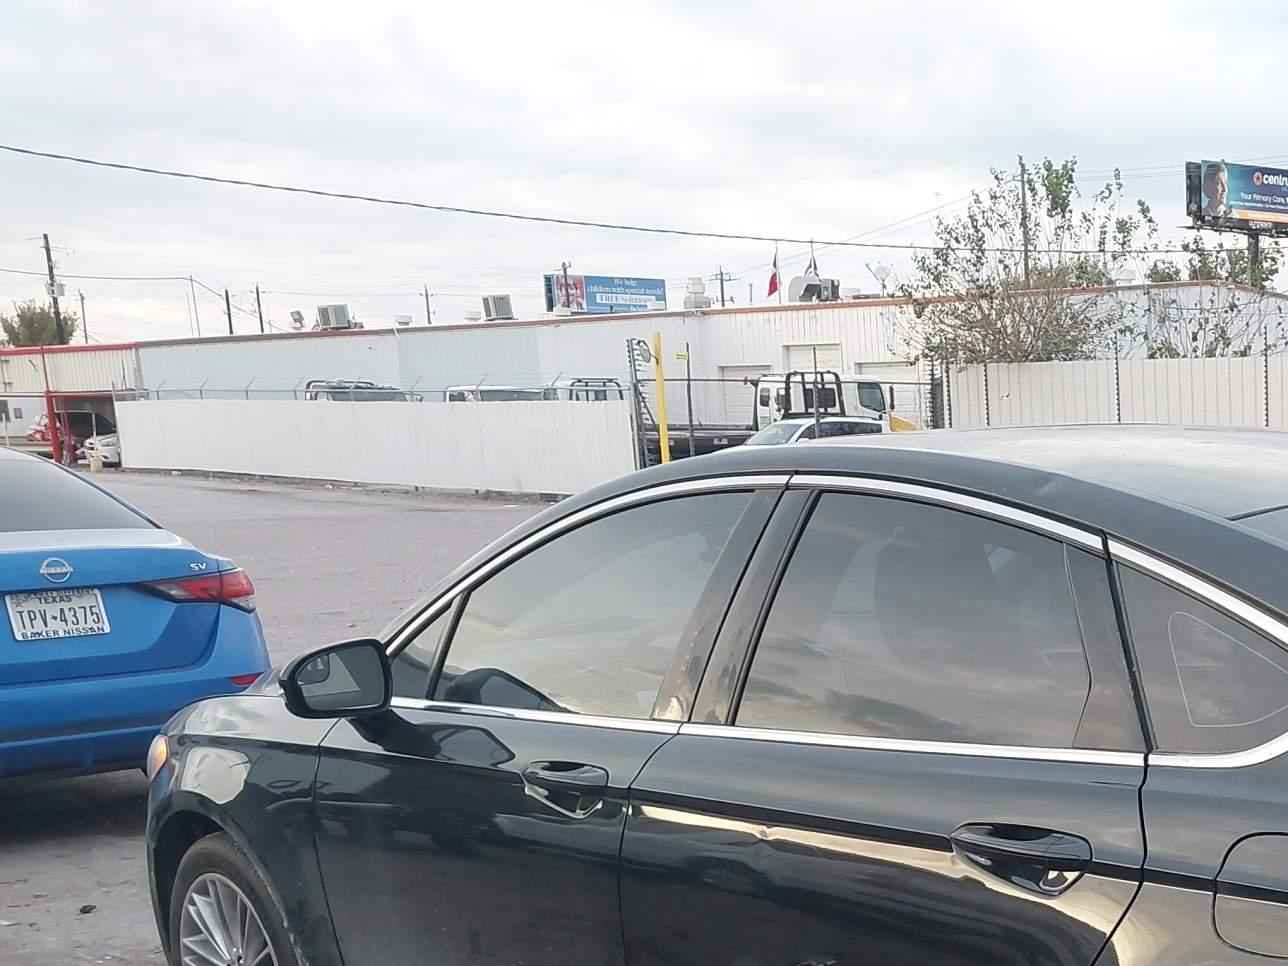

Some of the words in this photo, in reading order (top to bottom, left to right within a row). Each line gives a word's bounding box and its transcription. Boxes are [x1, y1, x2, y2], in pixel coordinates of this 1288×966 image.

[1253, 193, 1272, 204] Primary
[190, 562, 207, 571] SV
[37, 595, 73, 605] TEXAS
[16, 608, 48, 630] TPV
[60, 605, 101, 627] 4375
[22, 629, 60, 640] BAKER
[63, 625, 105, 637] NISSAN
